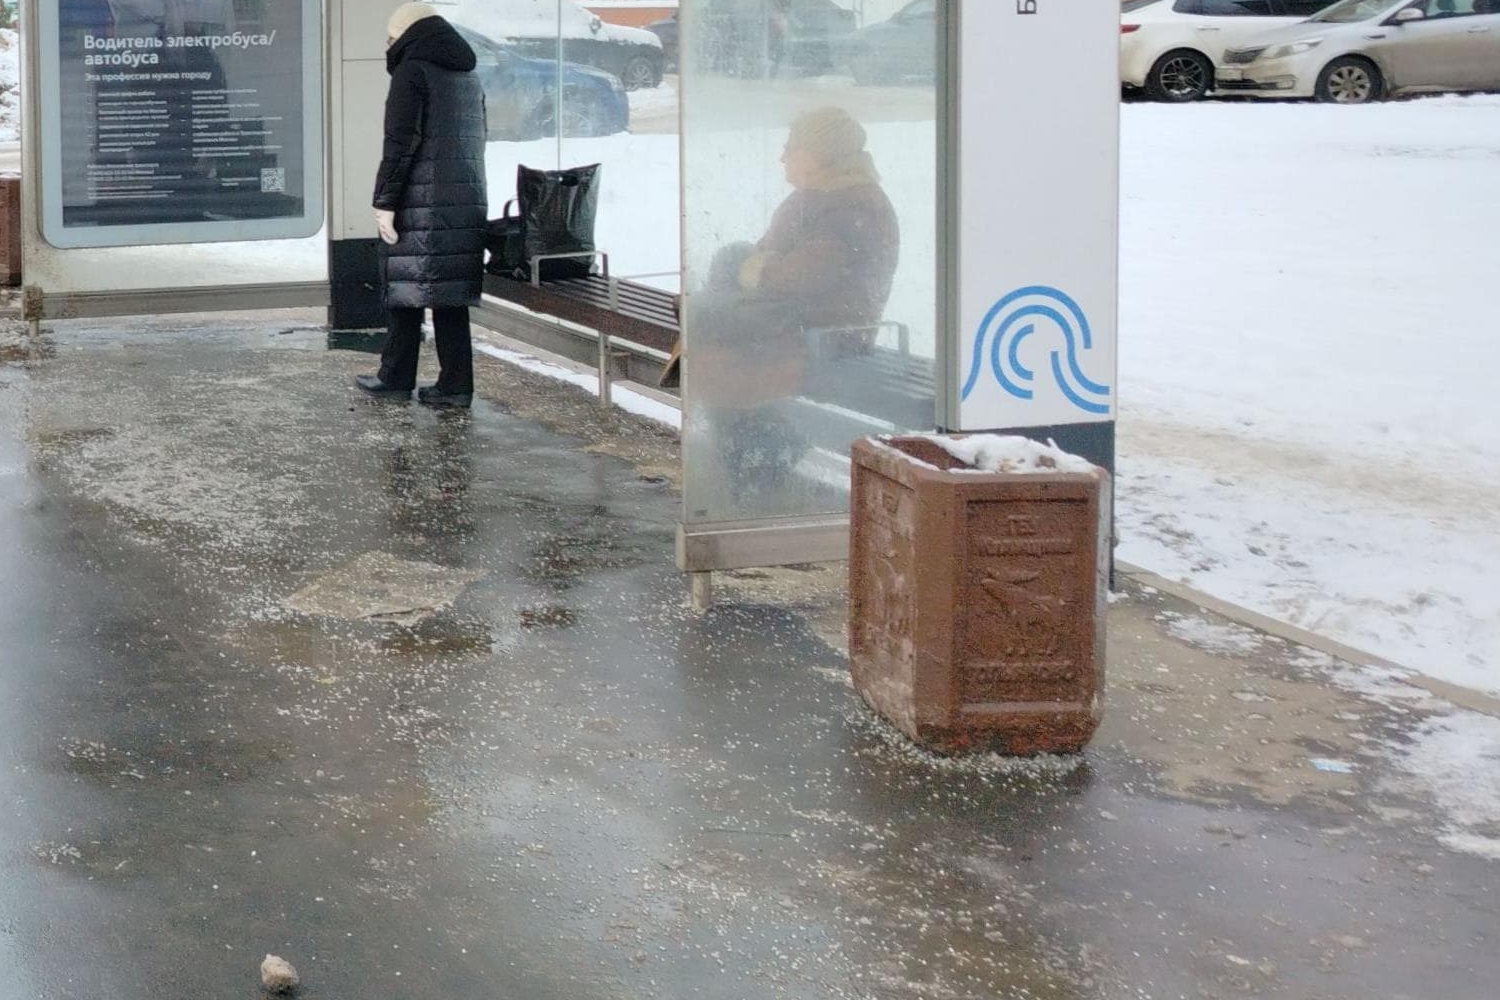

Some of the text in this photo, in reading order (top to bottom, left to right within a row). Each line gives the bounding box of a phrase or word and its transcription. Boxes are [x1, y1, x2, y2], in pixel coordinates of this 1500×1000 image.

[84, 29, 277, 51] Водитель электробуса/
[84, 50, 159, 68] автобуса
